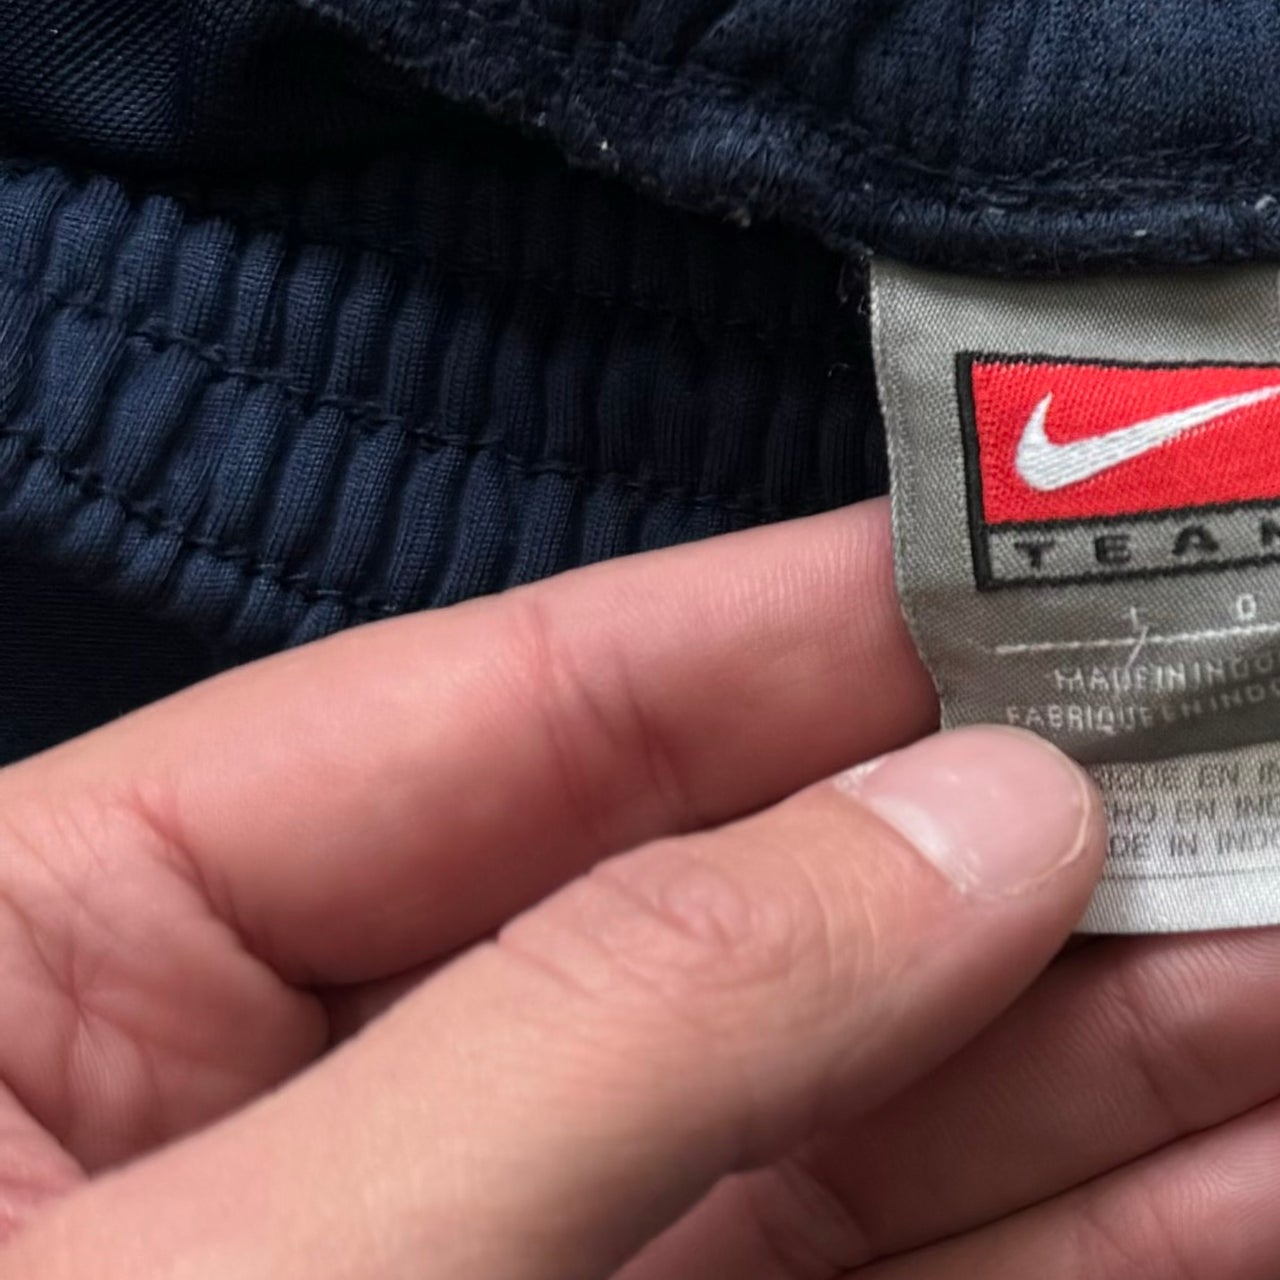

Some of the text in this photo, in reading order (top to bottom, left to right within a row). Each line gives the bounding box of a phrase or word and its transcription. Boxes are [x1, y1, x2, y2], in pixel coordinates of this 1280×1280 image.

[1093, 763, 1181, 792] IQUE
[1174, 796, 1217, 825] EN
[1104, 831, 1151, 859] DE
[1168, 831, 1199, 859] IN
